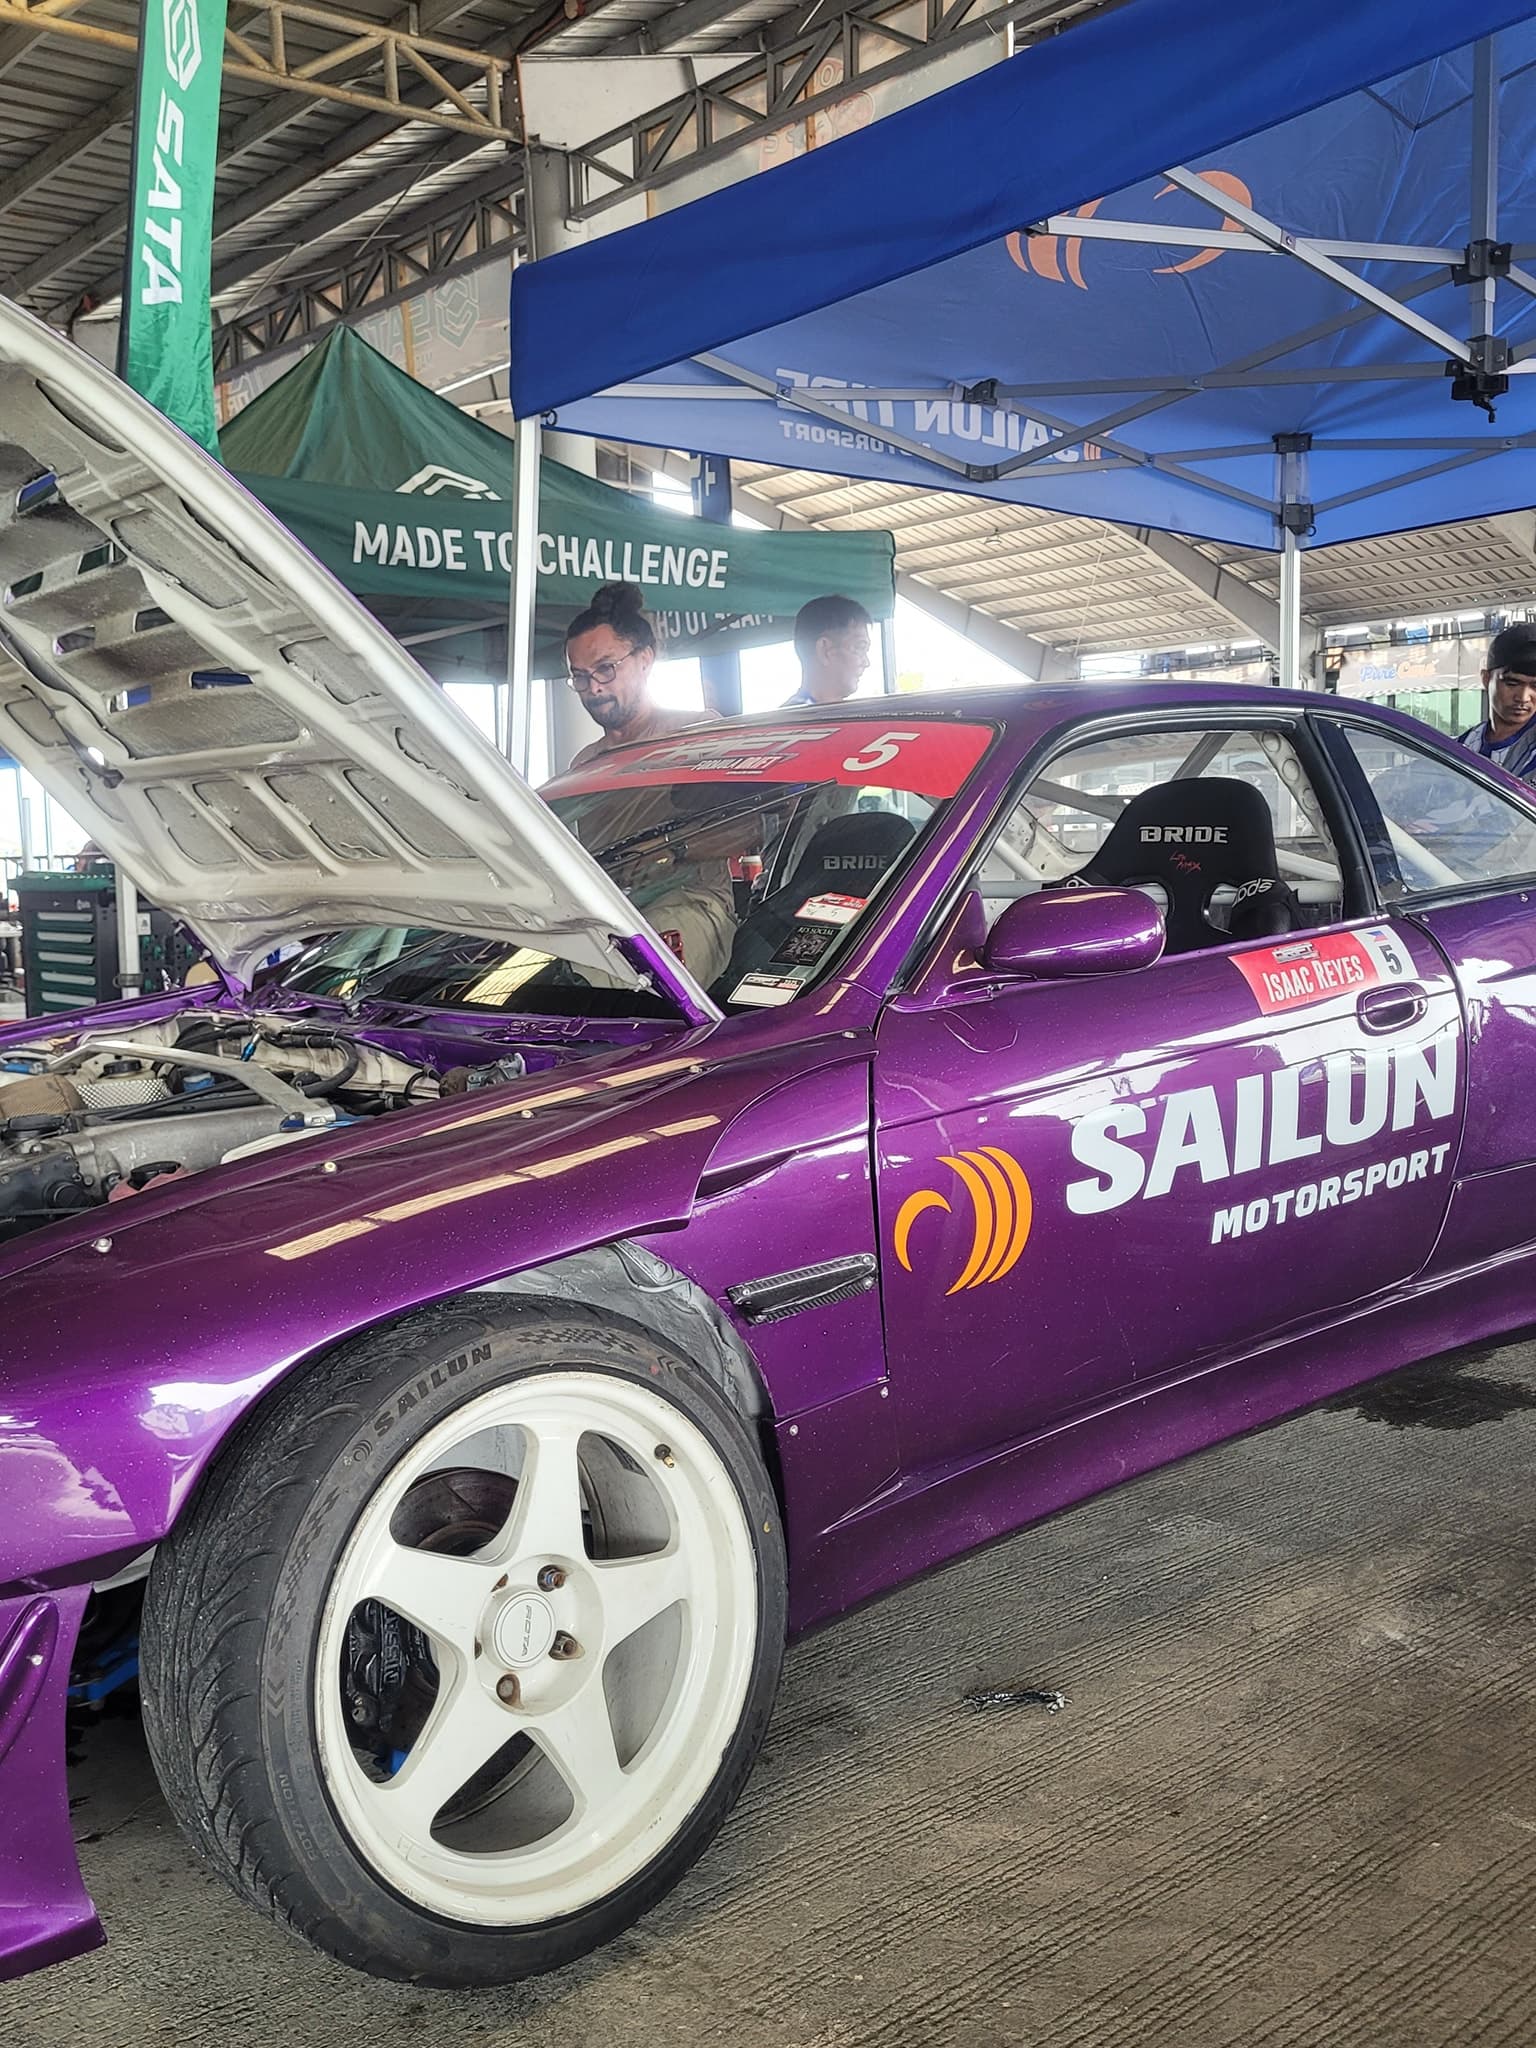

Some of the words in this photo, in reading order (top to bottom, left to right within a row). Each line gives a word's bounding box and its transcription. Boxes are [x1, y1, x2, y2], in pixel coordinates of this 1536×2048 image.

[142, 87, 184, 305] SATA
[352, 520, 467, 571] MADE
[474, 530, 514, 573] TO
[536, 533, 729, 589] CHALLENGE
[842, 731, 921, 772] 5
[822, 854, 888, 870] BRIDE
[1139, 826, 1229, 844] BRIDE
[1261, 966, 1315, 1003] ISAAC
[1312, 955, 1367, 990] REYES
[1378, 944, 1403, 976] 5
[1066, 1029, 1461, 1216] SAILUN
[1210, 1142, 1452, 1245] MOTORSPORT
[373, 1343, 493, 1438] SAILUN
